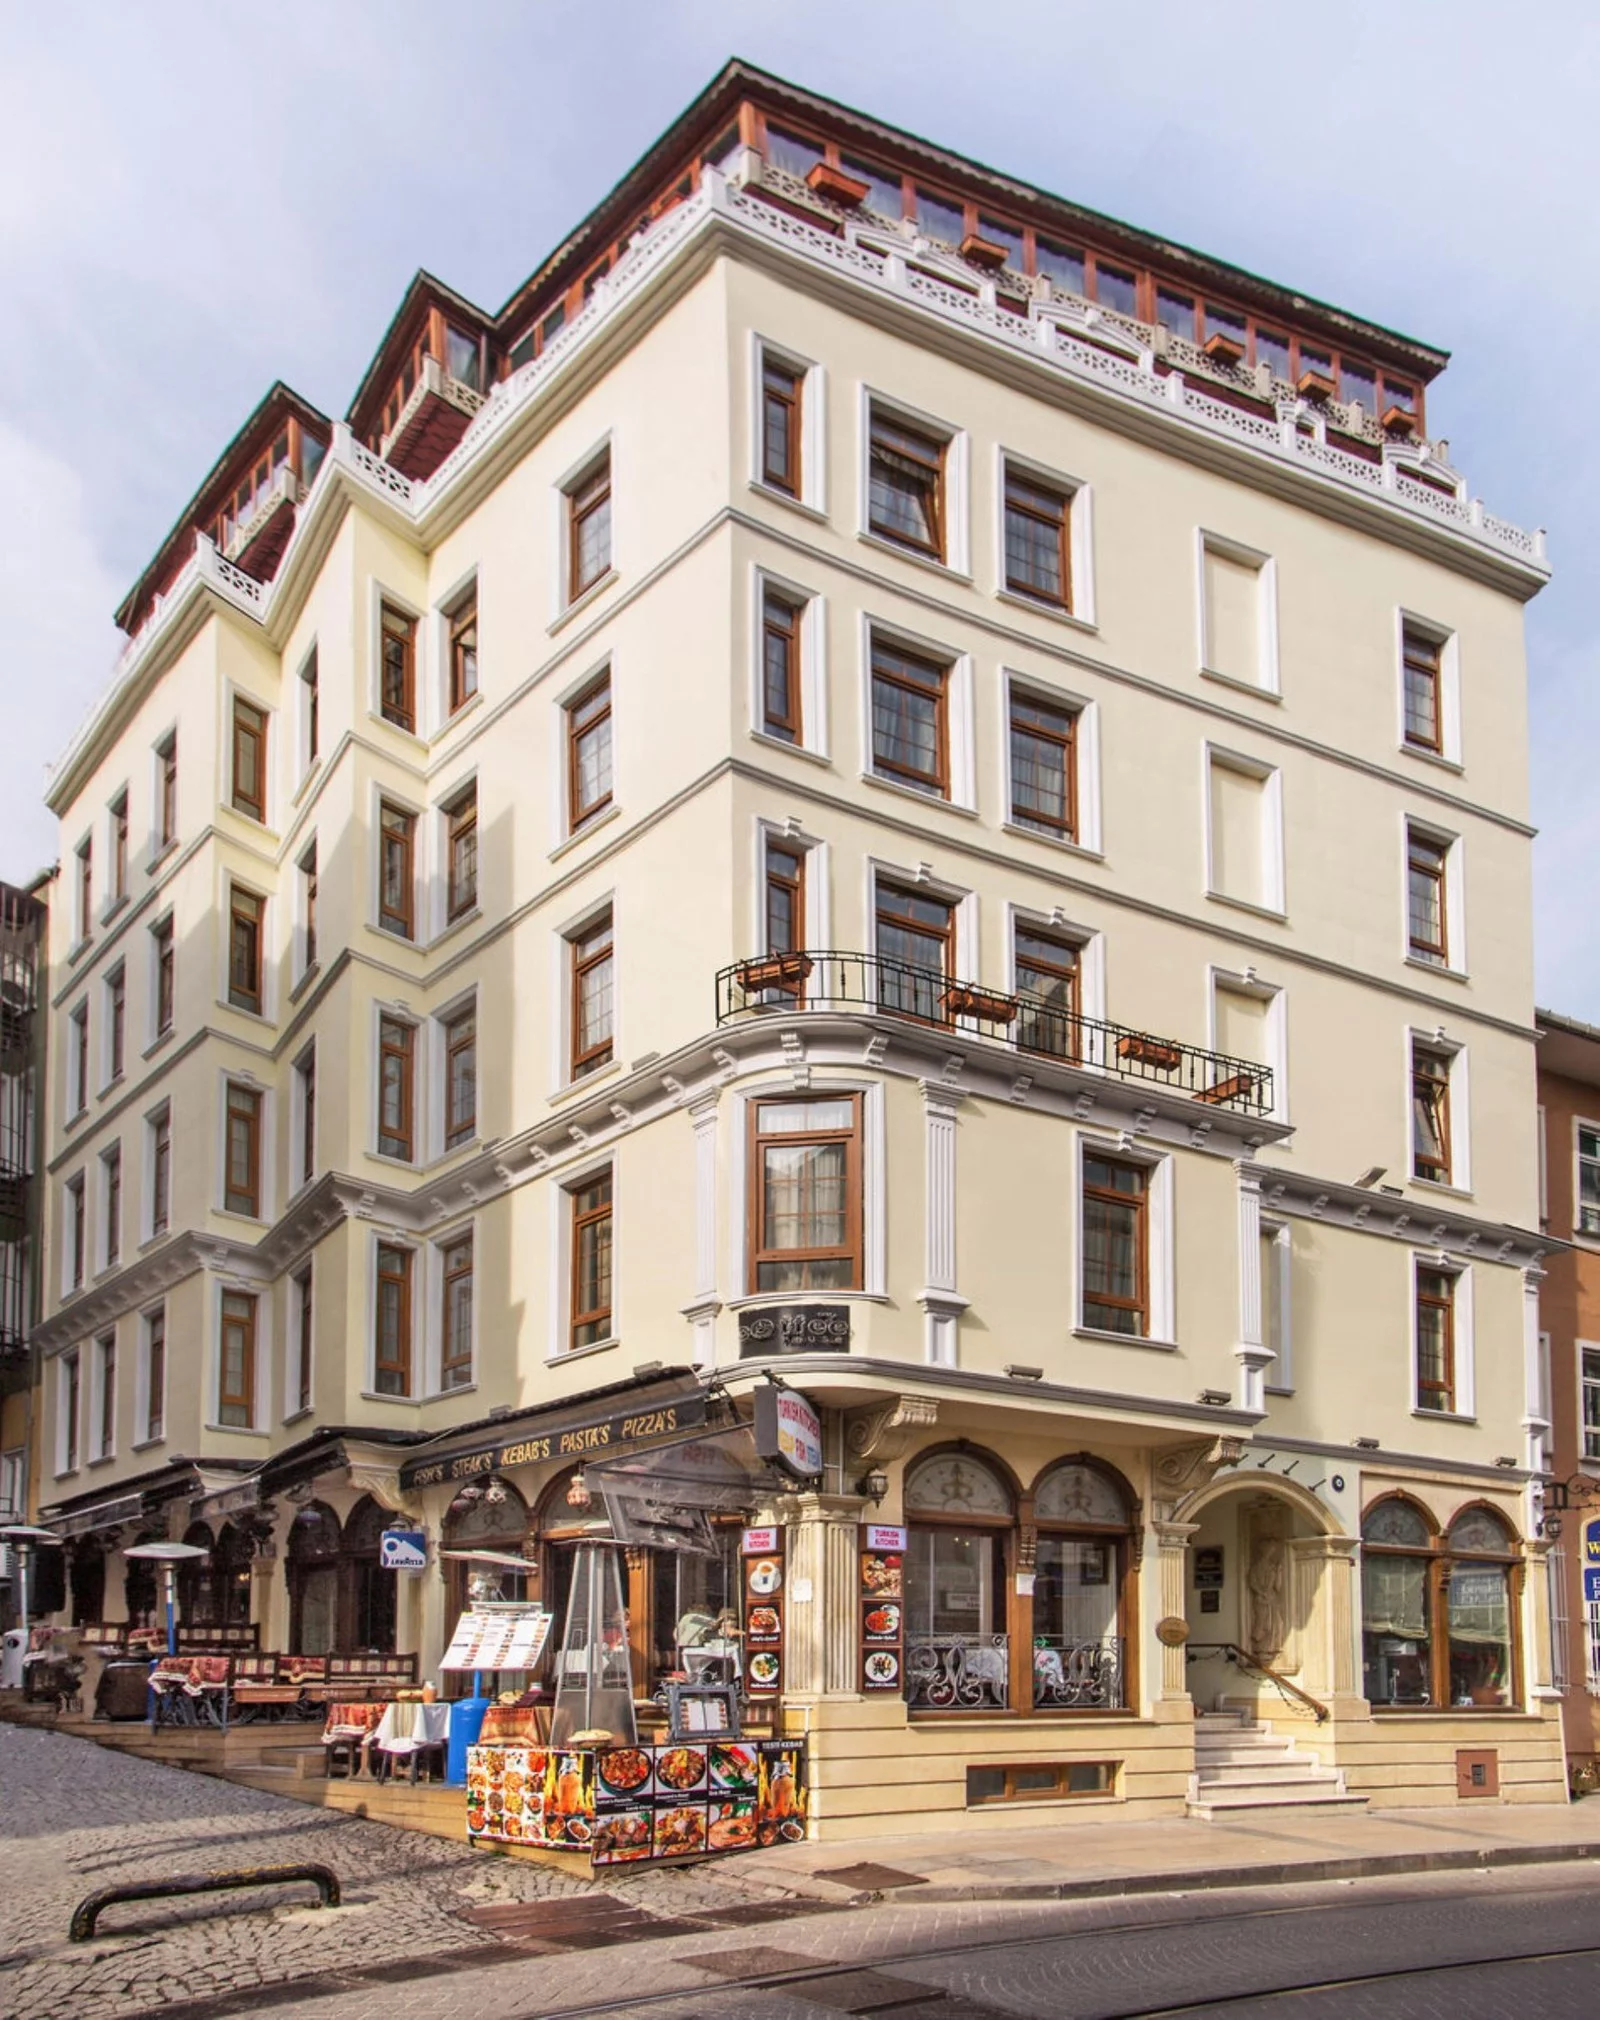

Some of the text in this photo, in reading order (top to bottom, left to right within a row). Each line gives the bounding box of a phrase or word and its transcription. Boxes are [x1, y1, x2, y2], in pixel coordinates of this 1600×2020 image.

[501, 1438, 551, 1466] KEBAB'S
[560, 1424, 611, 1454] PASTA'S
[622, 1408, 677, 1438] PIZZA'S
